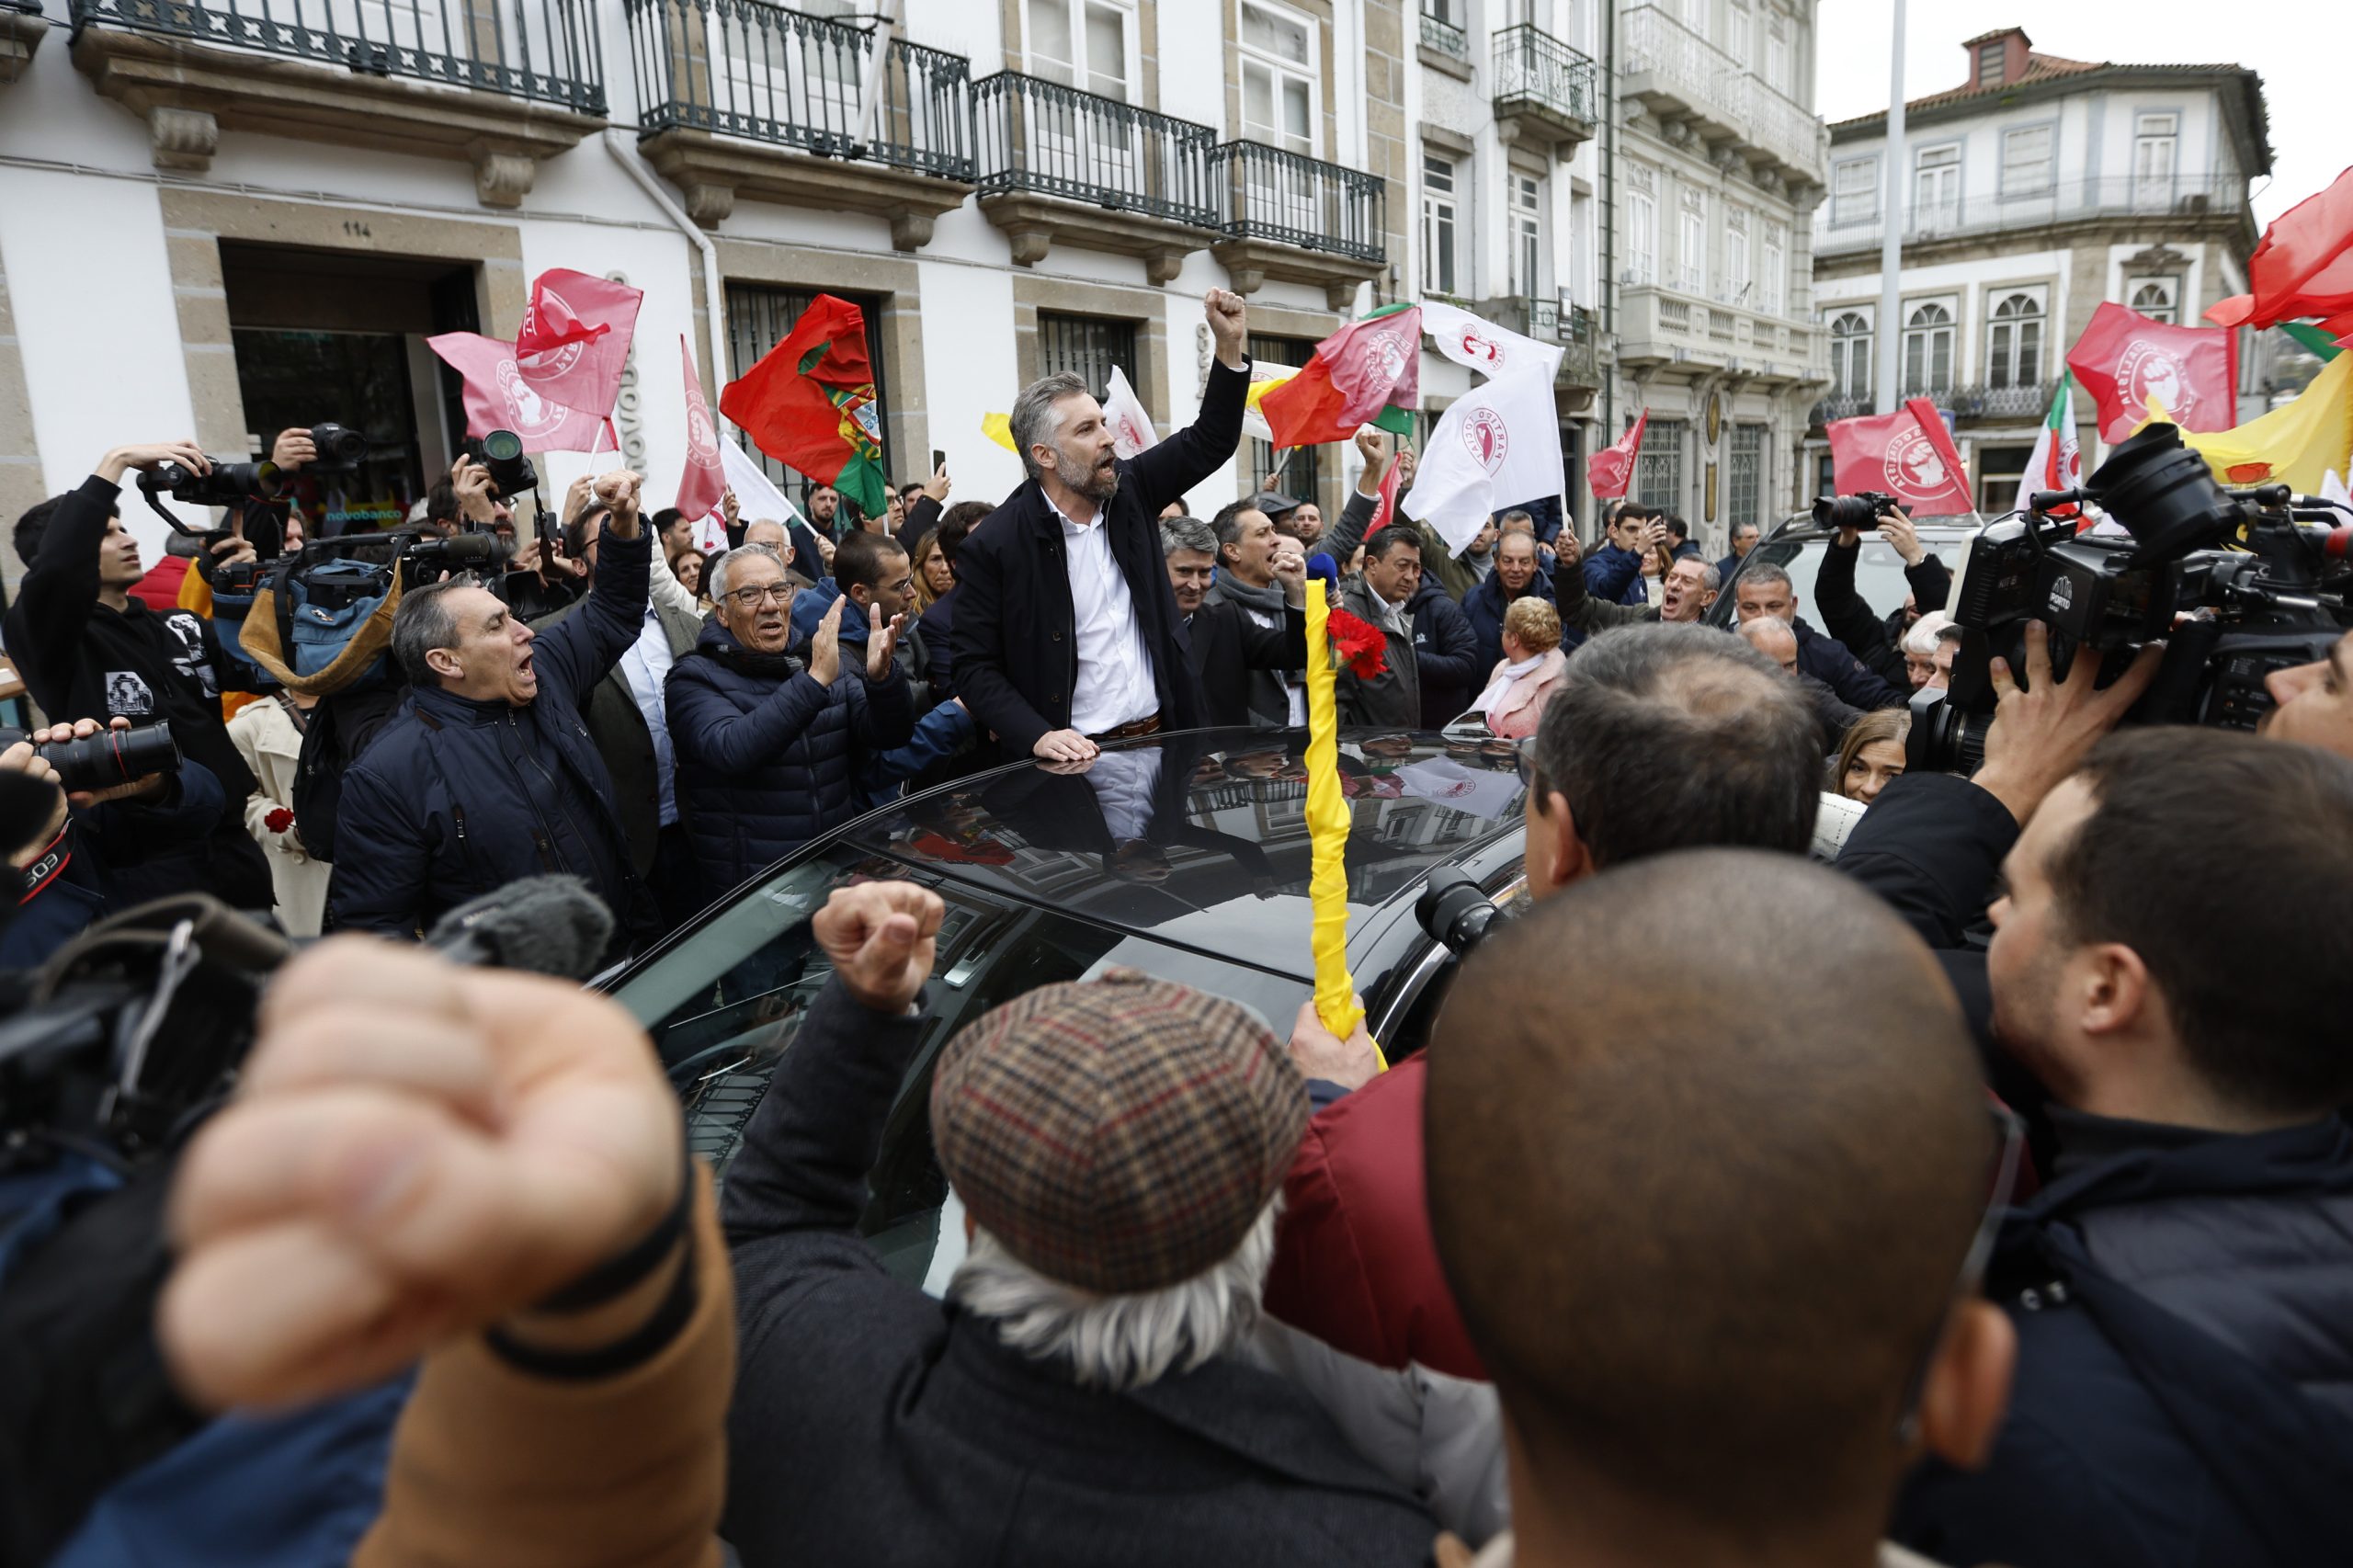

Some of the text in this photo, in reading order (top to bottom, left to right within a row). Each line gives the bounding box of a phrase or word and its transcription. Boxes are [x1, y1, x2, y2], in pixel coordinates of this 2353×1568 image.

[343, 220, 372, 238] 114
[325, 508, 403, 522] novobanco
[2049, 591, 2071, 610] PORTO
